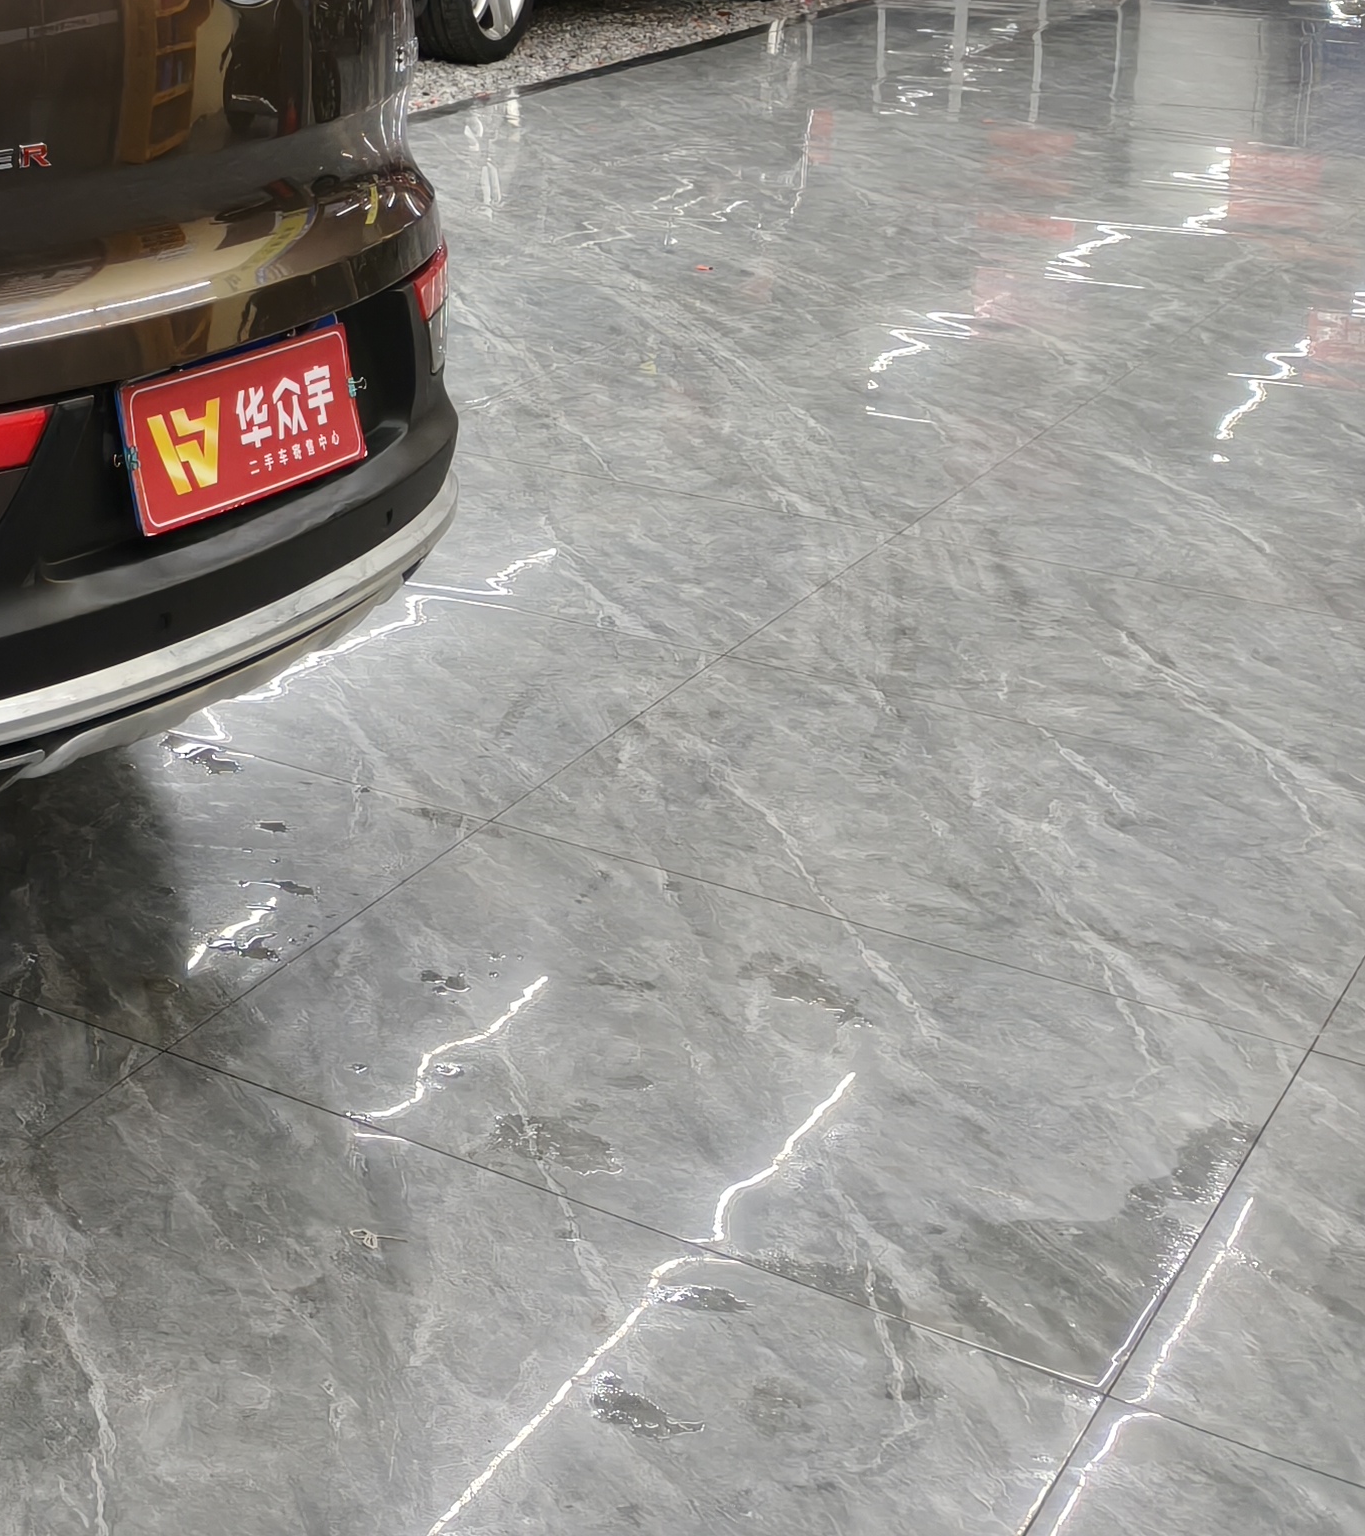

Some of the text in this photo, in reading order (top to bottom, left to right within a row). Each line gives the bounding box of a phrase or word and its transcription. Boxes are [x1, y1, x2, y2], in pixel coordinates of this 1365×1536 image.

[235, 365, 335, 449] 华众宇
[248, 429, 340, 476] 二手车寄售中心
